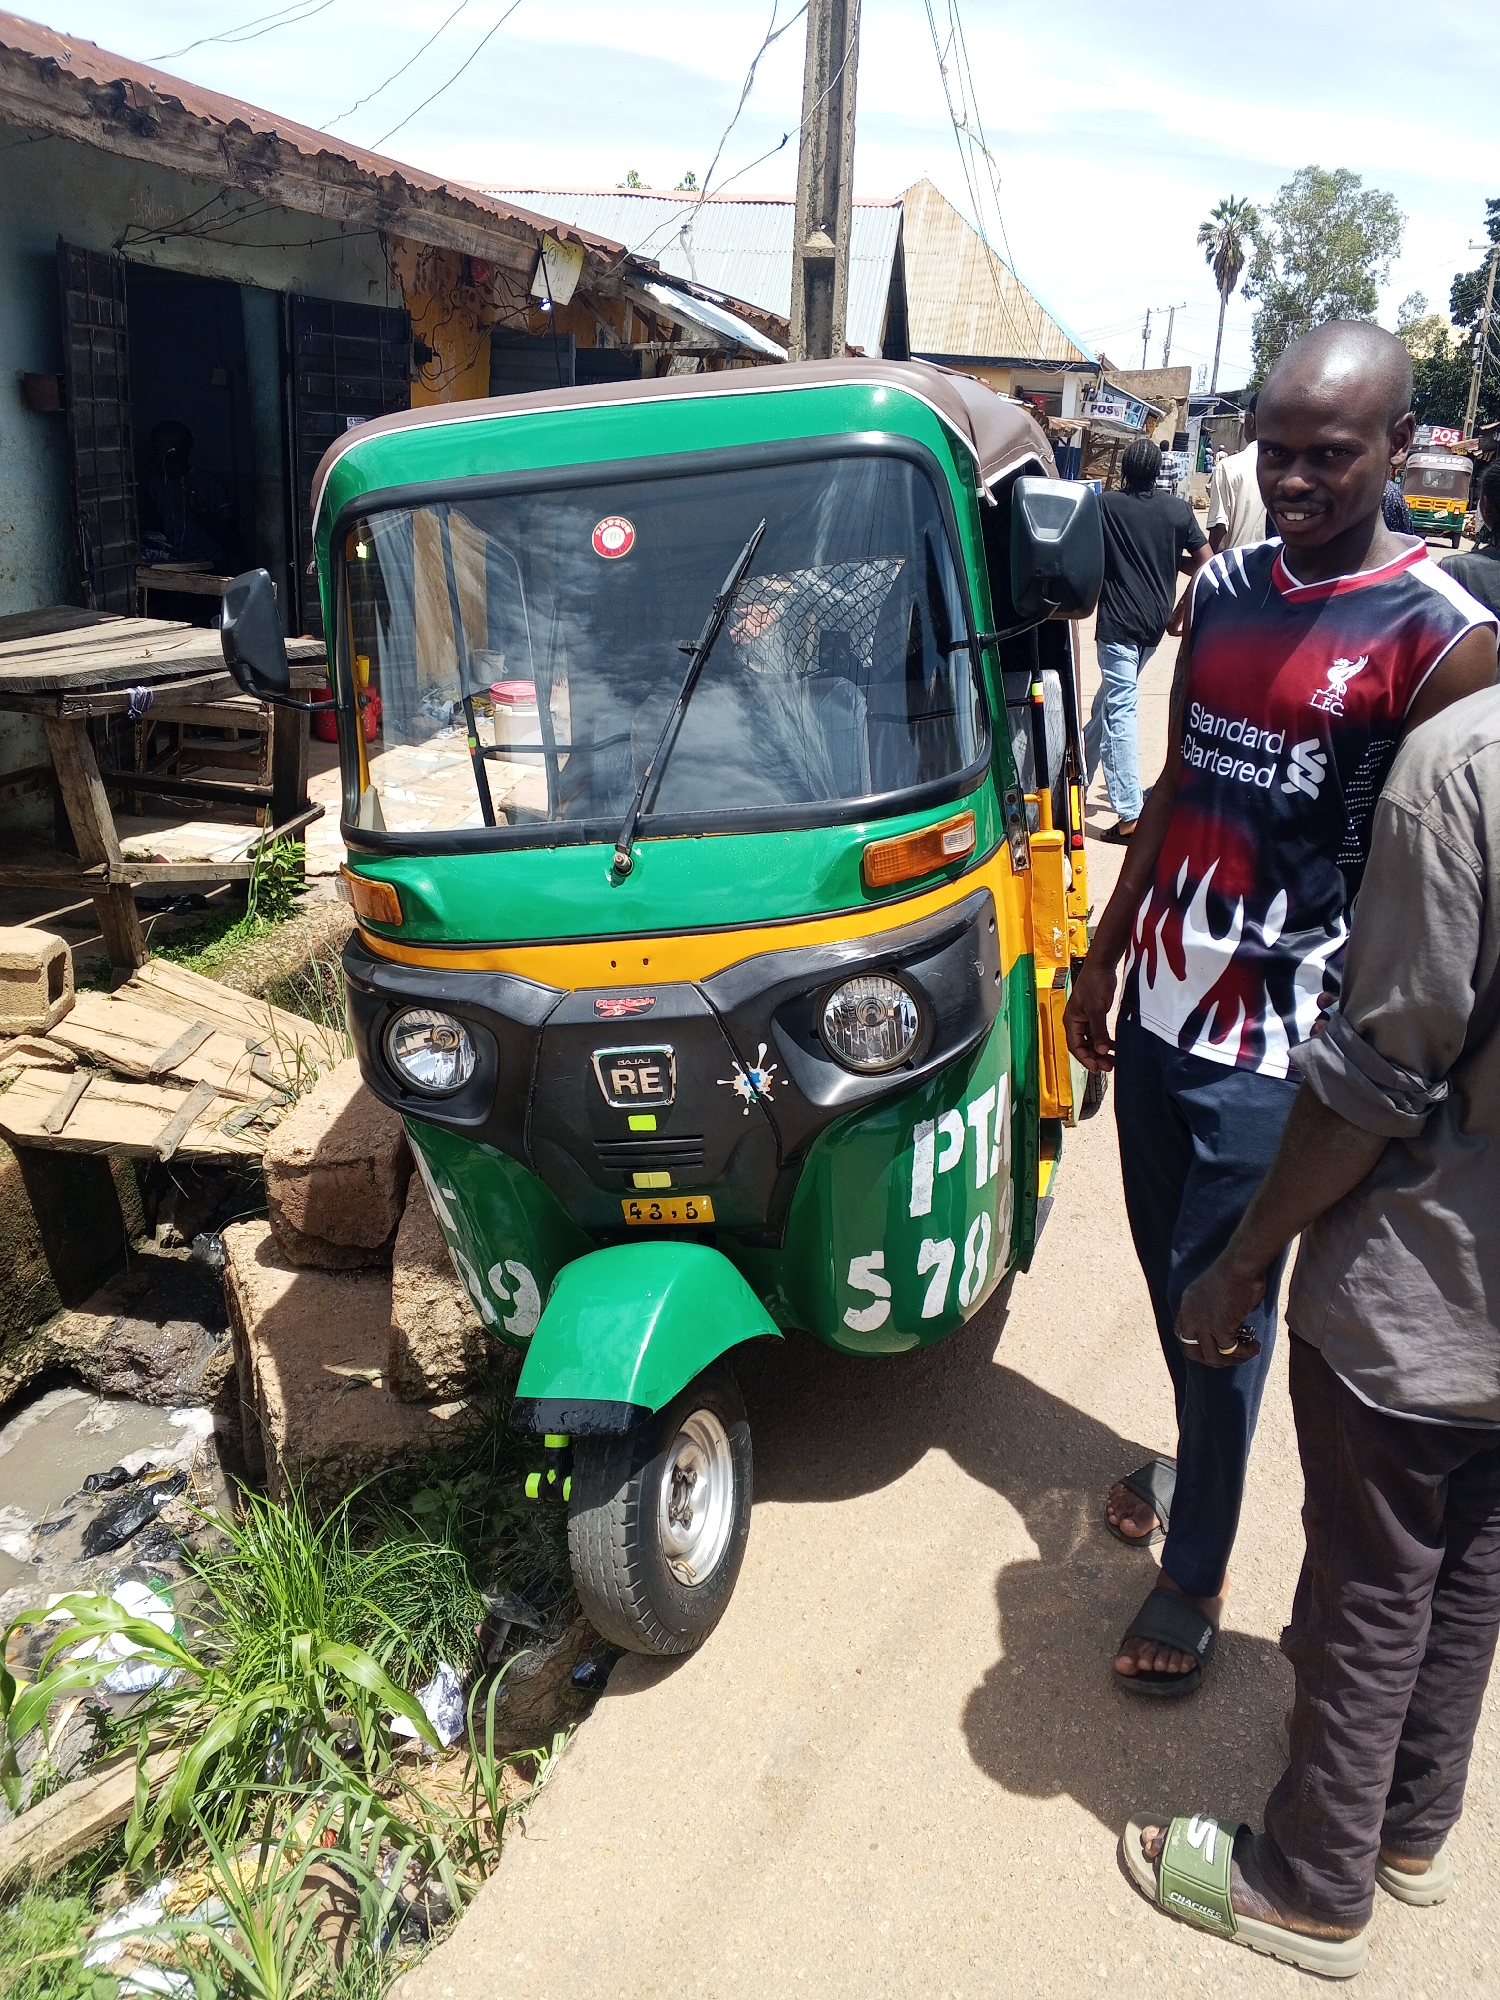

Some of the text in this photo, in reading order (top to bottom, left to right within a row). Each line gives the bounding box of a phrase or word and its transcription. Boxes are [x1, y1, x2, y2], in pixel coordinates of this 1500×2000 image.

[1090, 404, 1114, 415] POS
[1431, 427, 1461, 443] POS
[1190, 702, 1286, 754] Standard
[611, 1066, 664, 1095] RE
